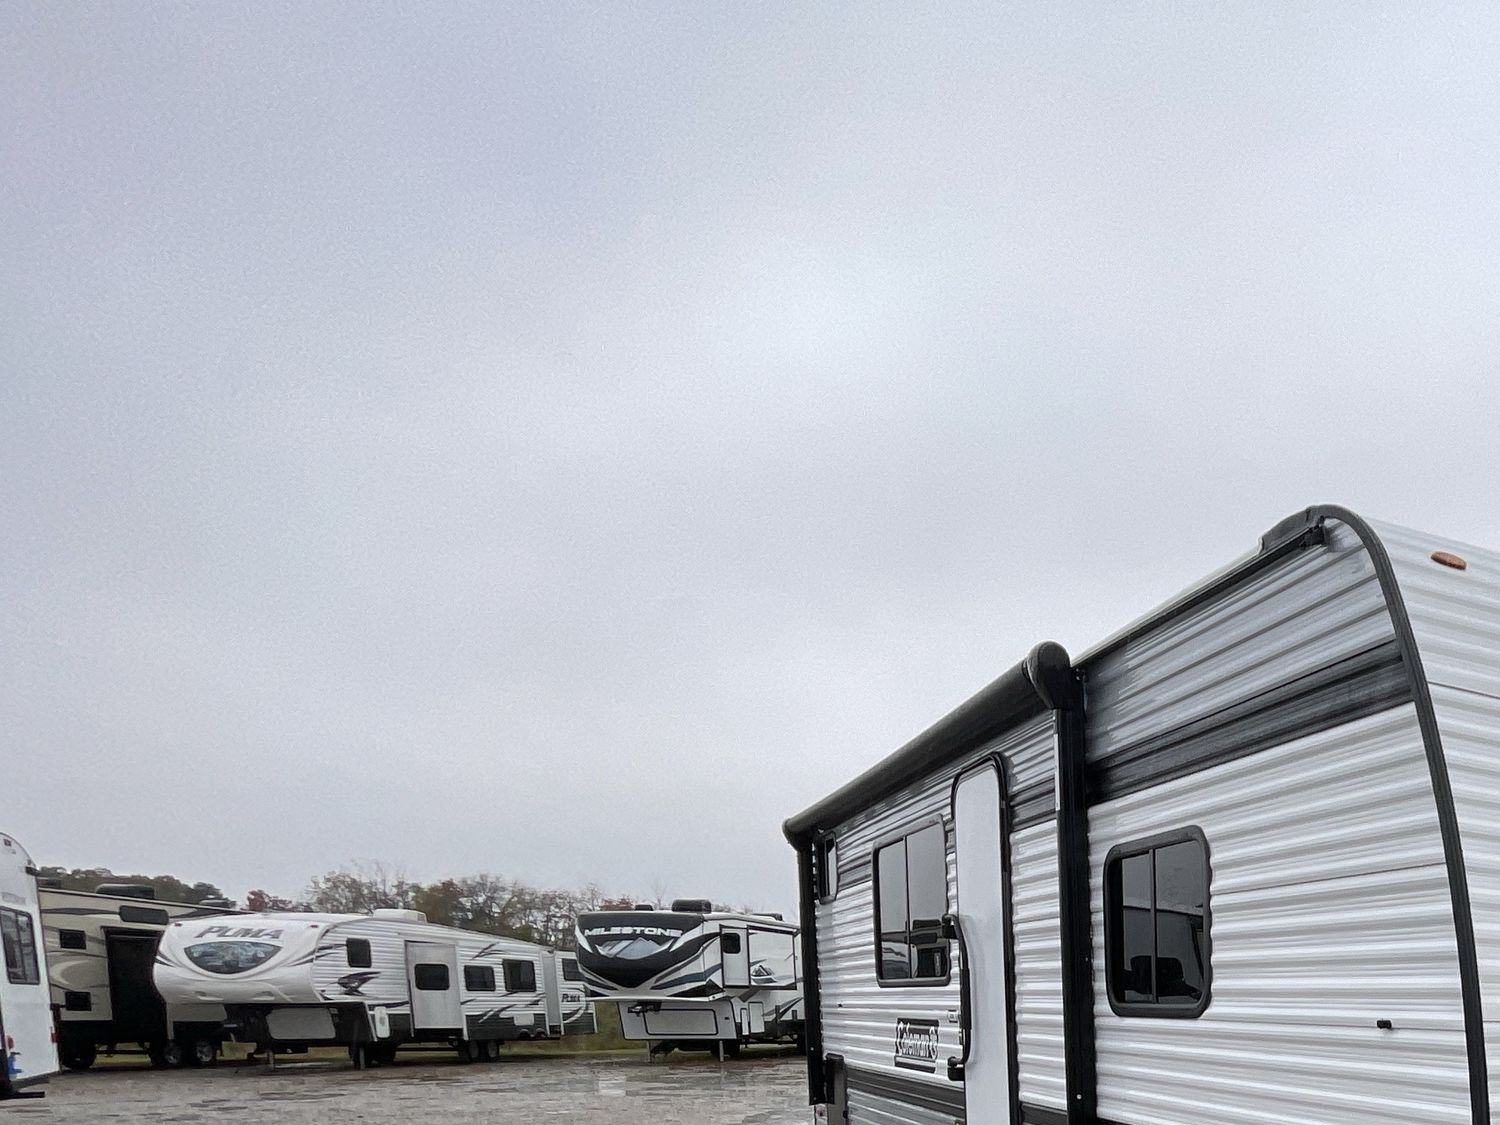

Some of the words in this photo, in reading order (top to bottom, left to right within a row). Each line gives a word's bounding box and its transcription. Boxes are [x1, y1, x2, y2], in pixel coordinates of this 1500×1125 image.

[193, 925, 284, 940] PUMA
[584, 926, 683, 938] MILESTONE
[896, 1021, 929, 1057] Coleman
